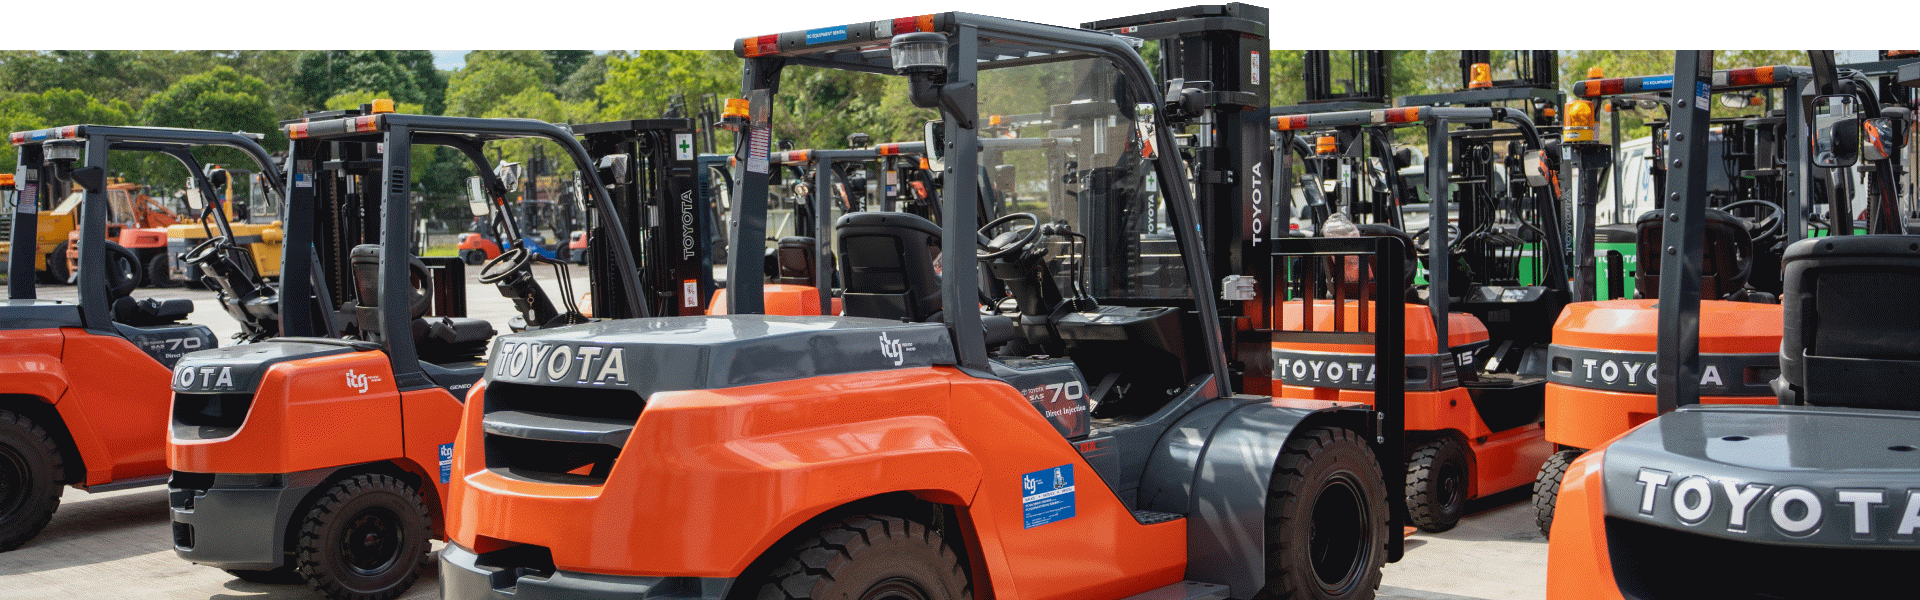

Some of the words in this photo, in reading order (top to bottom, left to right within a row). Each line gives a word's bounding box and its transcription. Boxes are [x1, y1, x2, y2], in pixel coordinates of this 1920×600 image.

[1147, 194, 1155, 234] OYOTA
[1252, 161, 1262, 247] TOYOTA
[681, 189, 694, 260] TOYOTA
[1565, 188, 1573, 256] TOYOTA
[165, 336, 201, 351] 70
[879, 331, 904, 367] itg
[498, 342, 627, 385] TOYOTA
[1457, 351, 1473, 366] 15
[345, 369, 369, 393] itg
[1582, 358, 1725, 386] TOYOA
[1029, 393, 1045, 401] SAS
[1045, 381, 1083, 403] 70
[1046, 408, 1062, 418] Direct
[1063, 404, 1086, 415] Injection
[1024, 474, 1036, 494] itg
